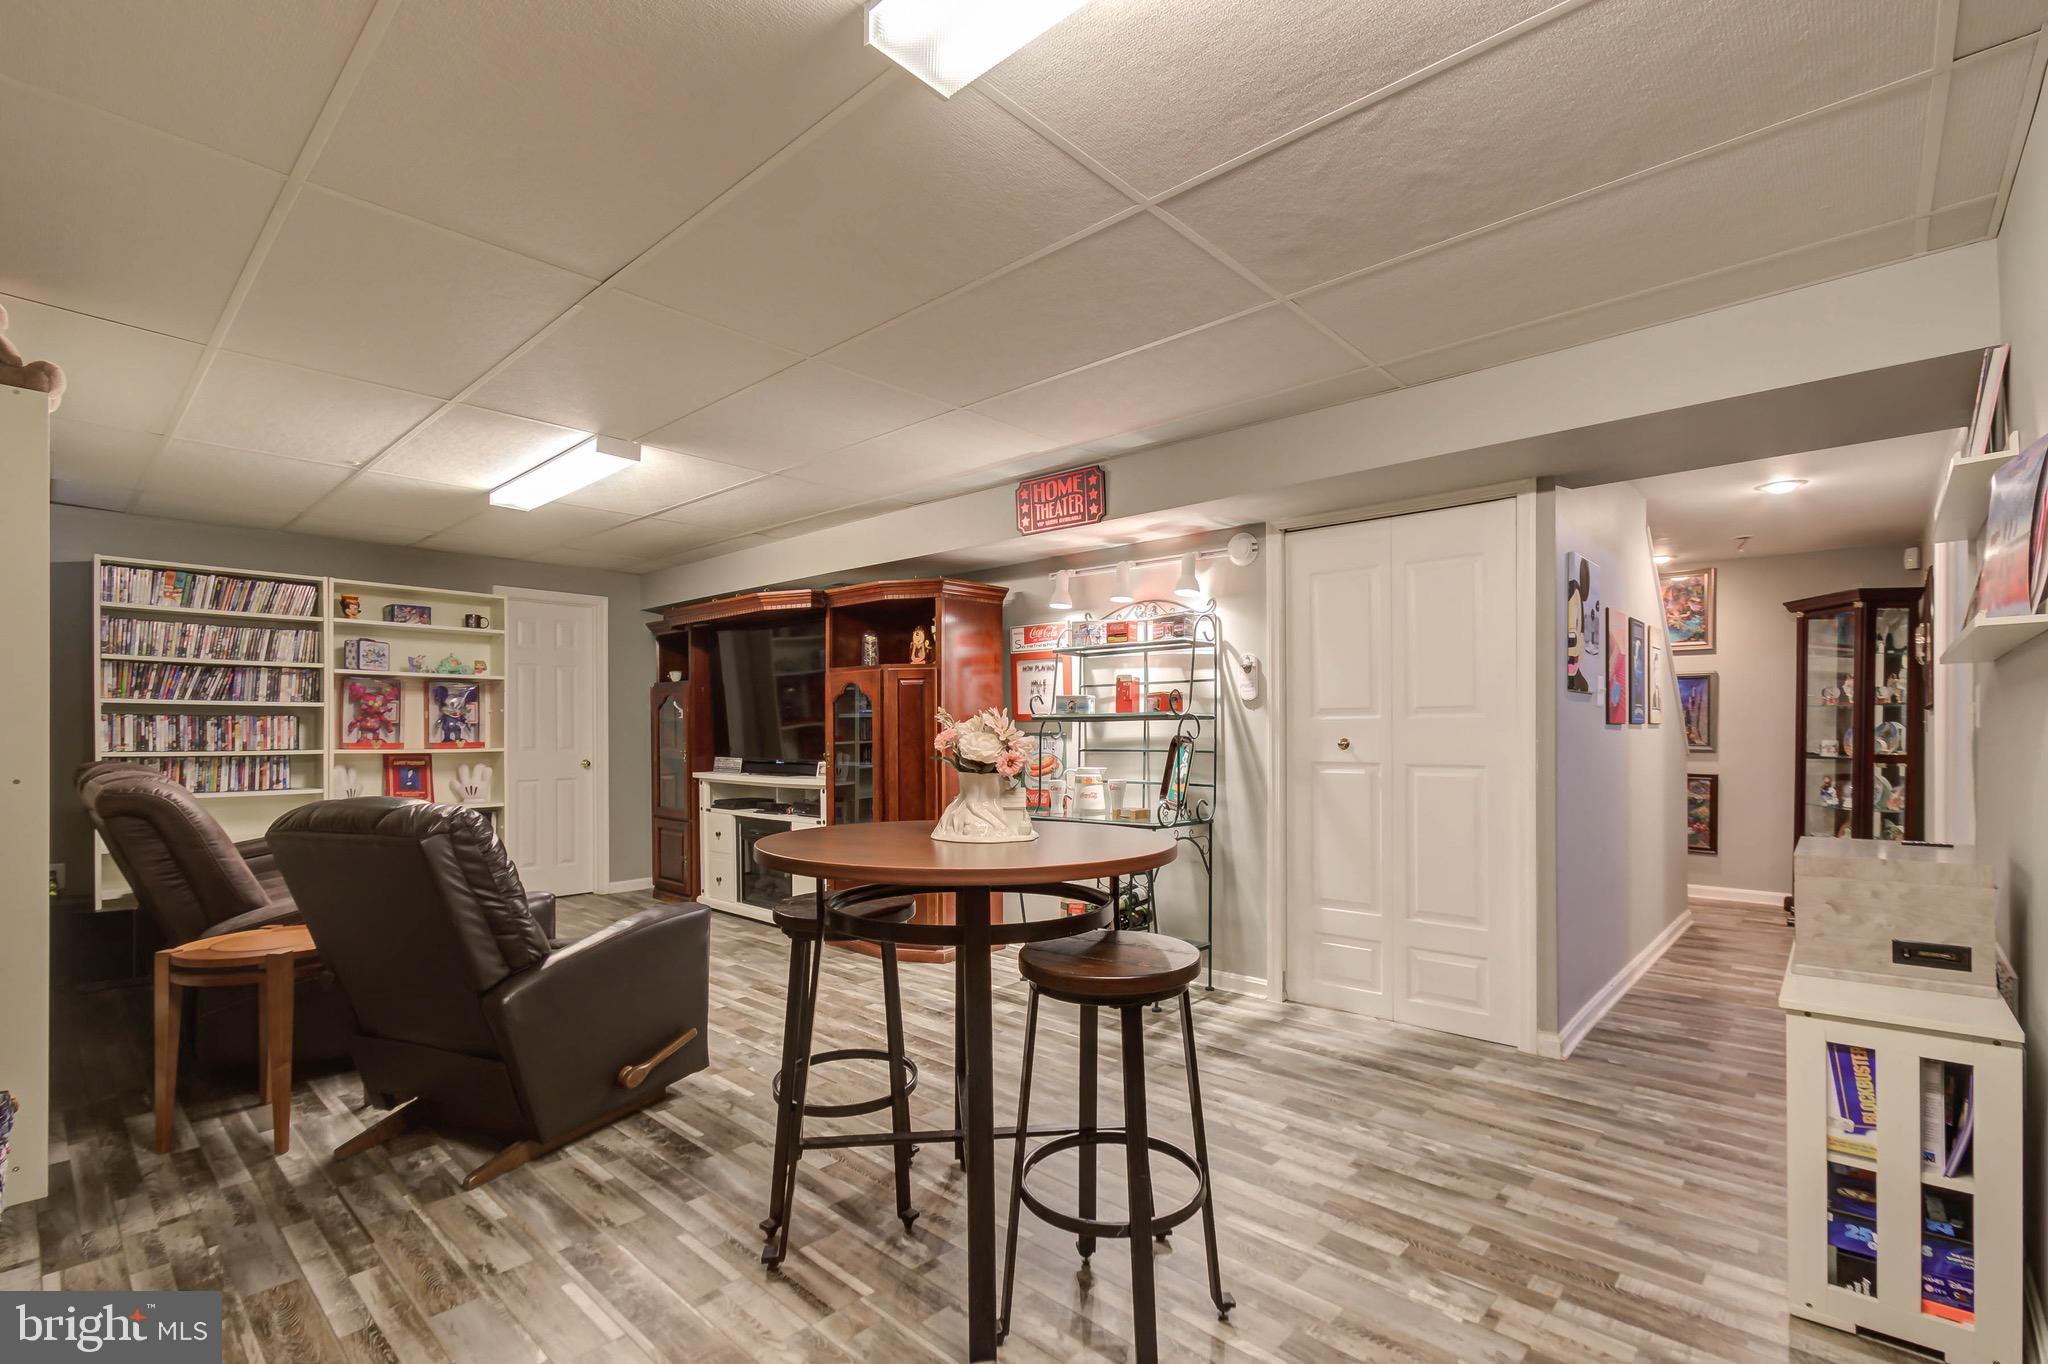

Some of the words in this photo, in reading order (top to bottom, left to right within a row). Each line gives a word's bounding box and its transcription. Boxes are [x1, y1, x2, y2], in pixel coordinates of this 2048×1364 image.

[1033, 474, 1083, 503] HOME
[1035, 493, 1084, 521] THEATER
[1850, 1047, 1877, 1125] BLOCKBUSTER
